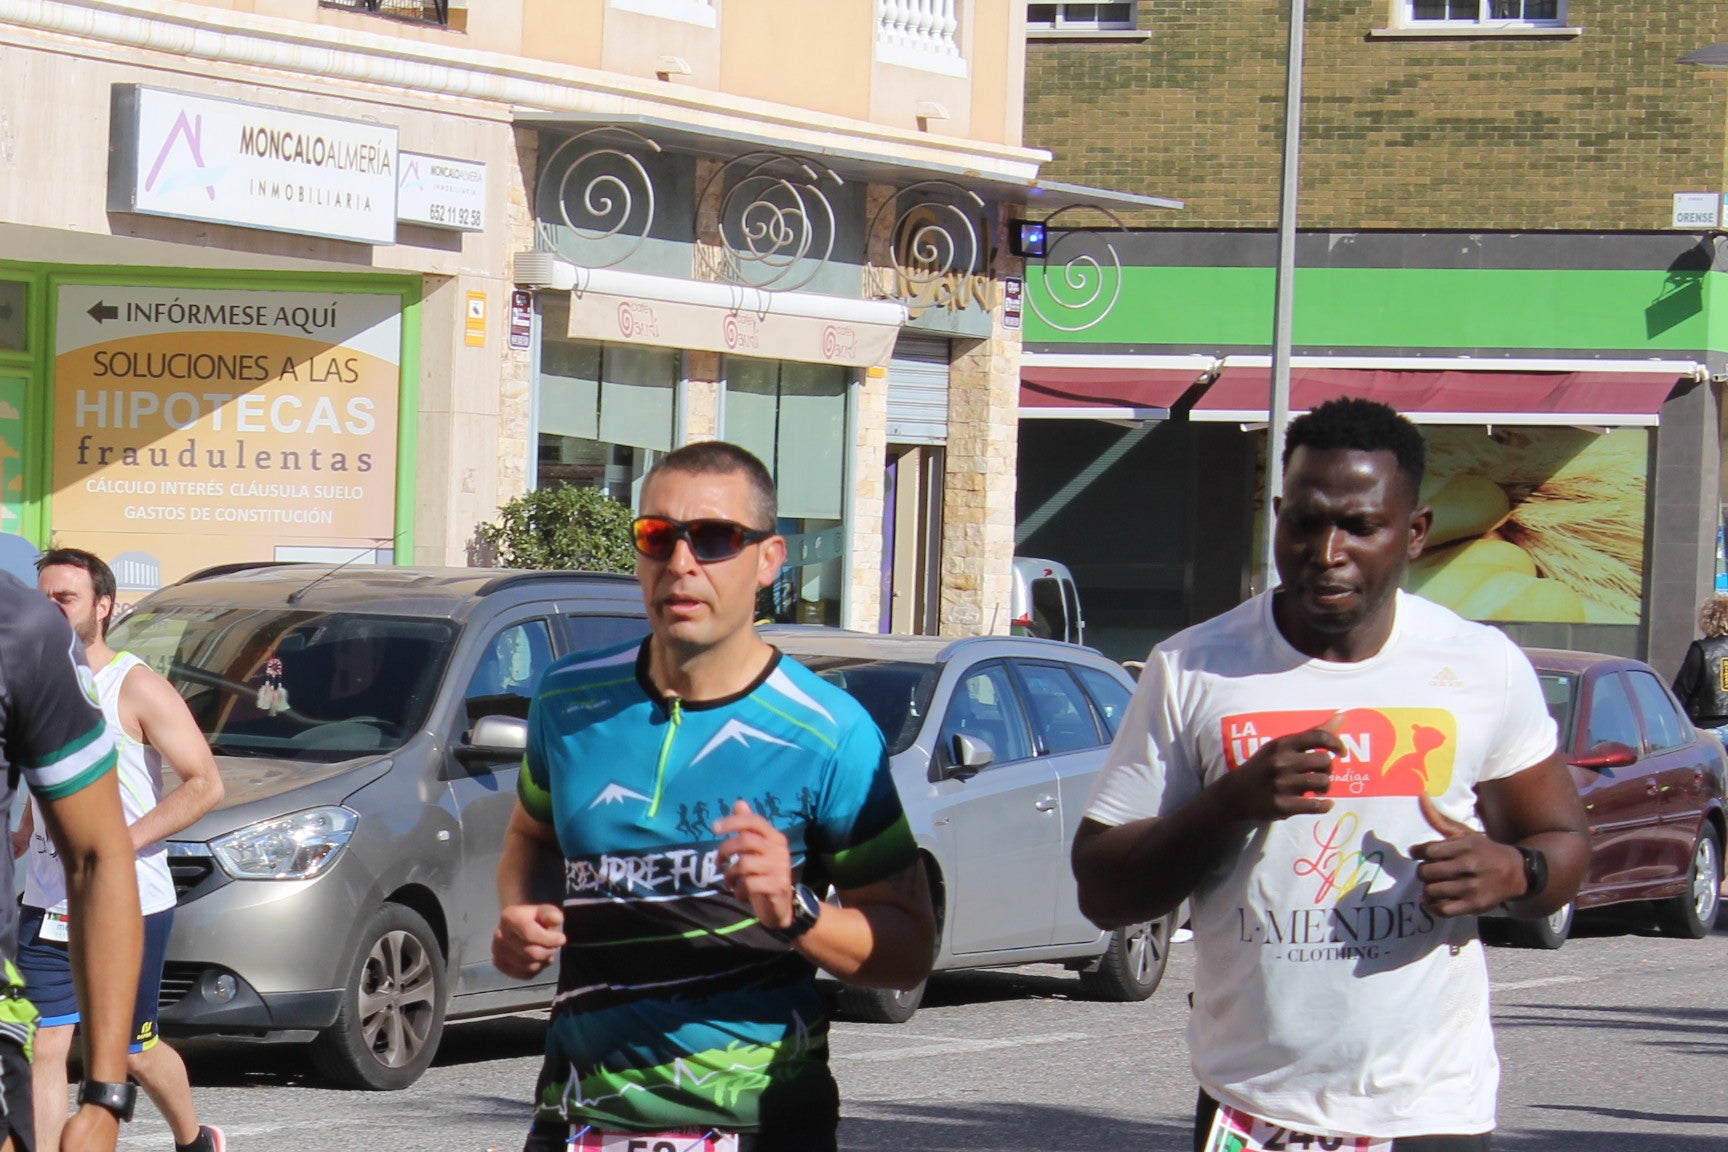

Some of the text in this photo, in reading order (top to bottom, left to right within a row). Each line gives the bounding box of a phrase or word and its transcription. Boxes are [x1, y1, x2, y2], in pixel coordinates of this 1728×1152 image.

[250, 178, 371, 212] INMOBILIARIA
[430, 204, 481, 226] 652 11 92 58
[1677, 213, 1714, 223] ORENSE
[127, 298, 336, 334] INFÓRMESE AQUÍ
[93, 351, 358, 383] SOLUCIONES A LAS
[75, 390, 376, 435] HIPOTECAS
[77, 435, 372, 472] fraudulentas
[86, 477, 363, 500] CÁLCULO INTERÉS CLÁUSULA SUELO
[124, 505, 332, 524] GASTOS DE CONSTITUCIÓN
[1231, 721, 1257, 738] LA
[1288, 946, 1379, 963] CLOTHING
